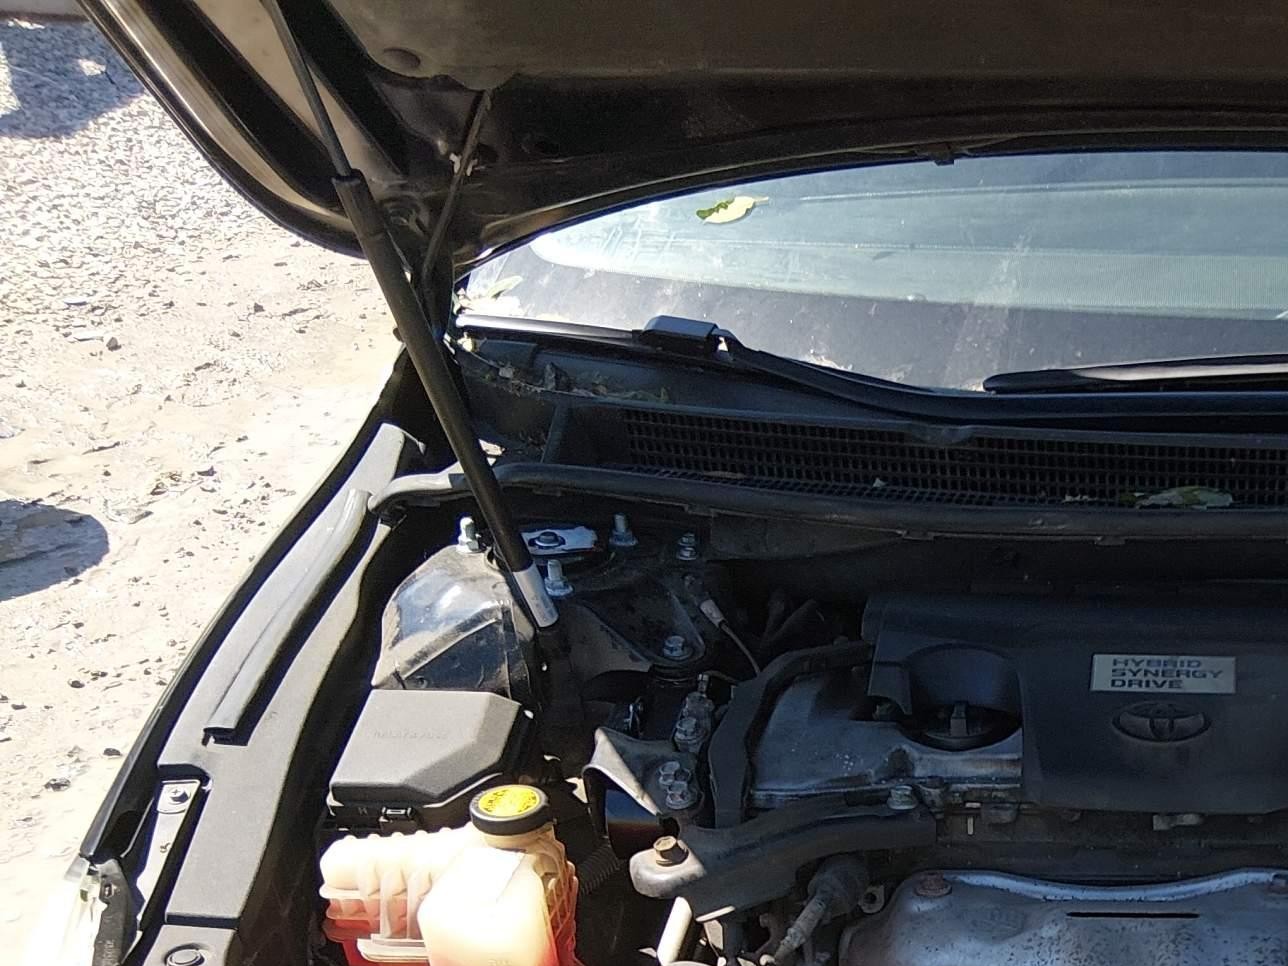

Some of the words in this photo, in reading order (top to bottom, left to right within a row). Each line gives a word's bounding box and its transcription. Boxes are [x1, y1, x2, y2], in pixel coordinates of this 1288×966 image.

[1112, 658, 1202, 669] HYBRID
[1111, 668, 1224, 679] SYNERGY
[1110, 678, 1184, 689] DRIVE
